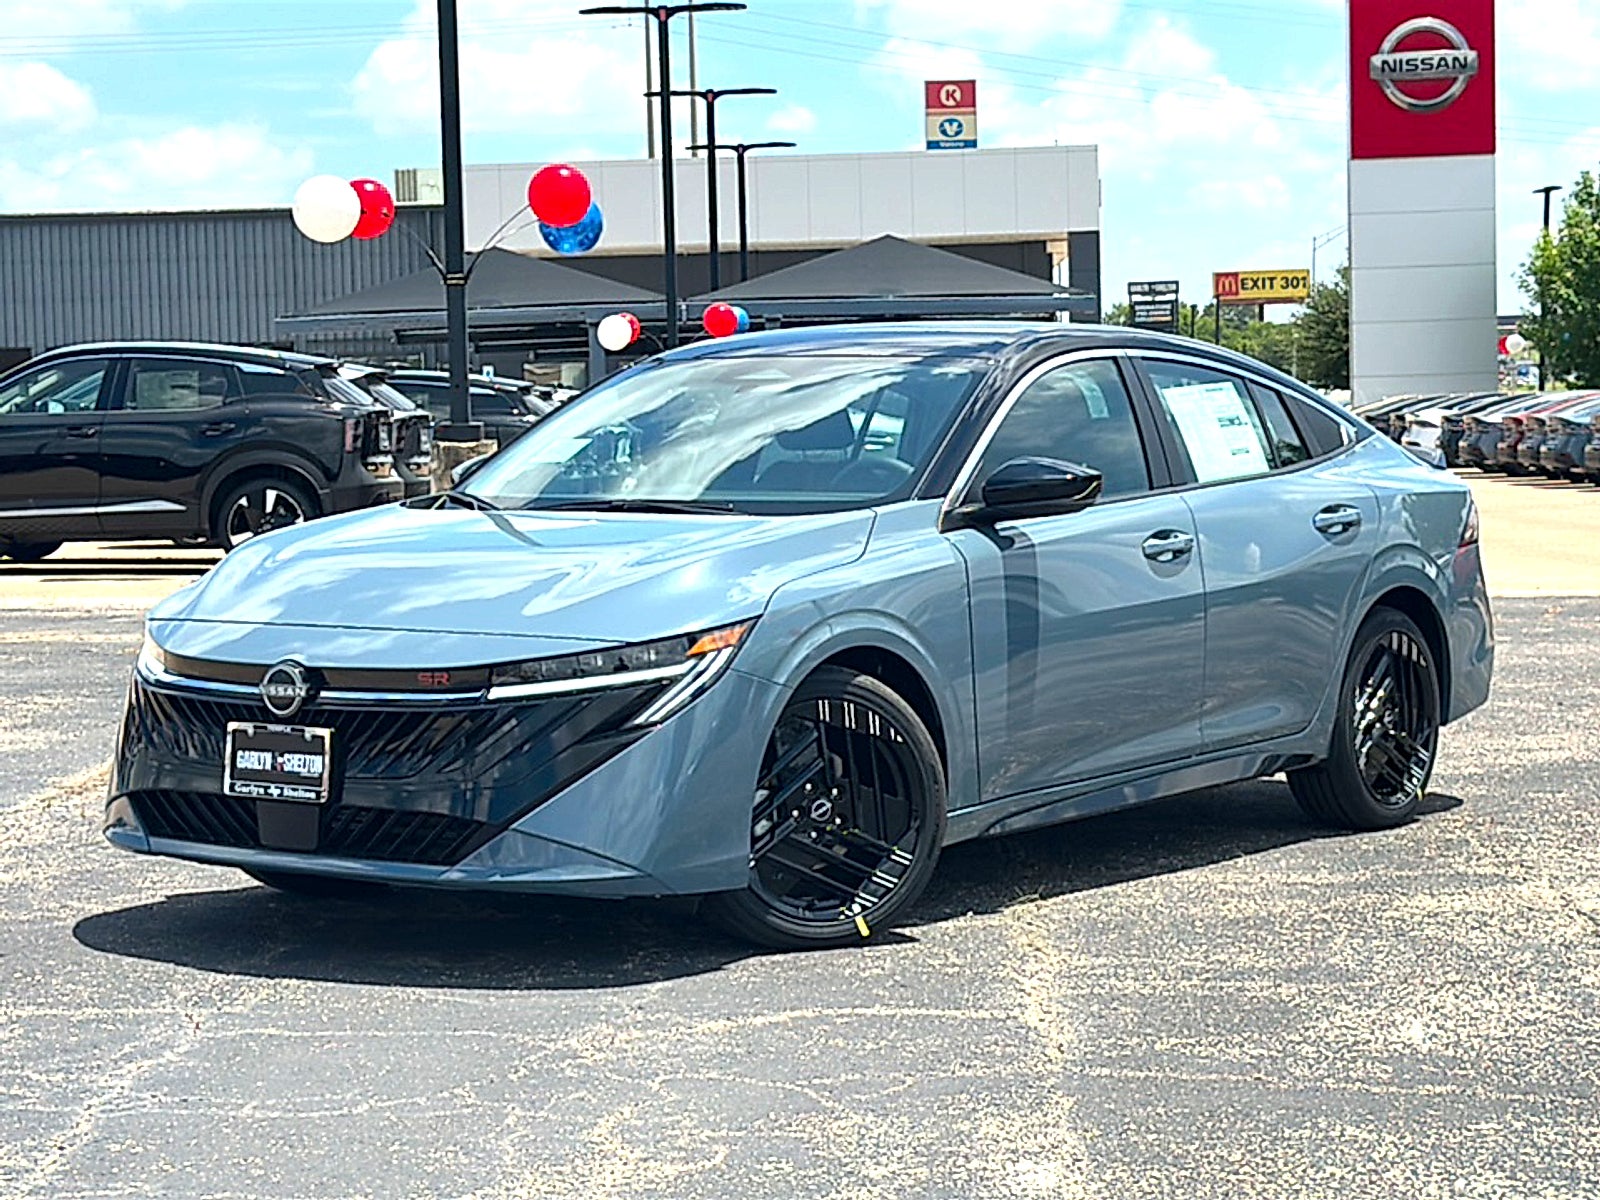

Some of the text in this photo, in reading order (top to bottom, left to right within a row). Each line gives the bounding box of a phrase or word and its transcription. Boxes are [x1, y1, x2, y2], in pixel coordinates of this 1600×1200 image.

[1381, 56, 1468, 73] NISSAN
[945, 88, 959, 104] K
[1240, 276, 1278, 291] EXIT
[1280, 275, 1307, 290] 301
[417, 672, 450, 688] SR
[236, 749, 323, 774] GARLYN SHELTON
